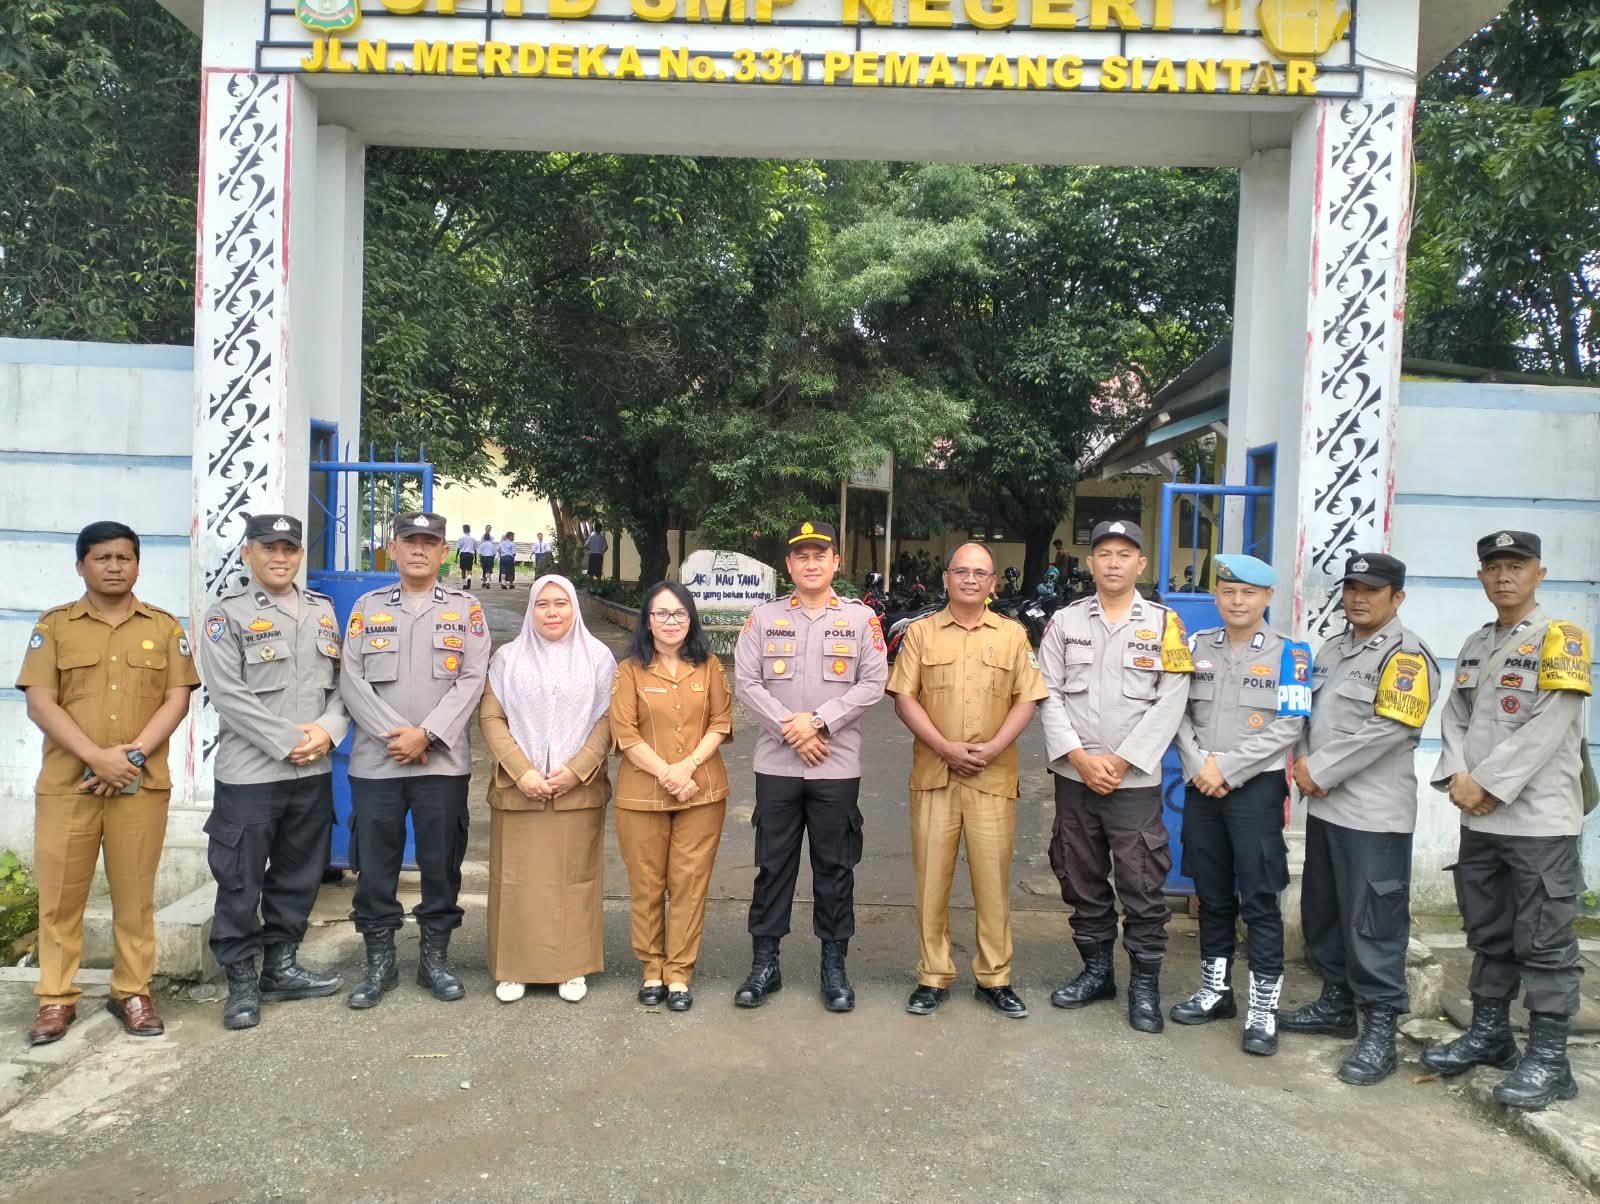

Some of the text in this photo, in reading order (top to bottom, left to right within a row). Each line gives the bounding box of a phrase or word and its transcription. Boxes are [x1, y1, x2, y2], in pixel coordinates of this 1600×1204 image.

[823, 51, 1084, 89] PEMATANG
[1100, 56, 1317, 95] SIANTAR
[703, 591, 721, 600] yang
[435, 623, 466, 633] POLRI
[766, 629, 796, 638] CHANDRA
[825, 630, 856, 638] POLRI
[1504, 657, 1537, 670] POLRI
[1350, 670, 1376, 683] POLRI
[1243, 677, 1276, 689] POLRI
